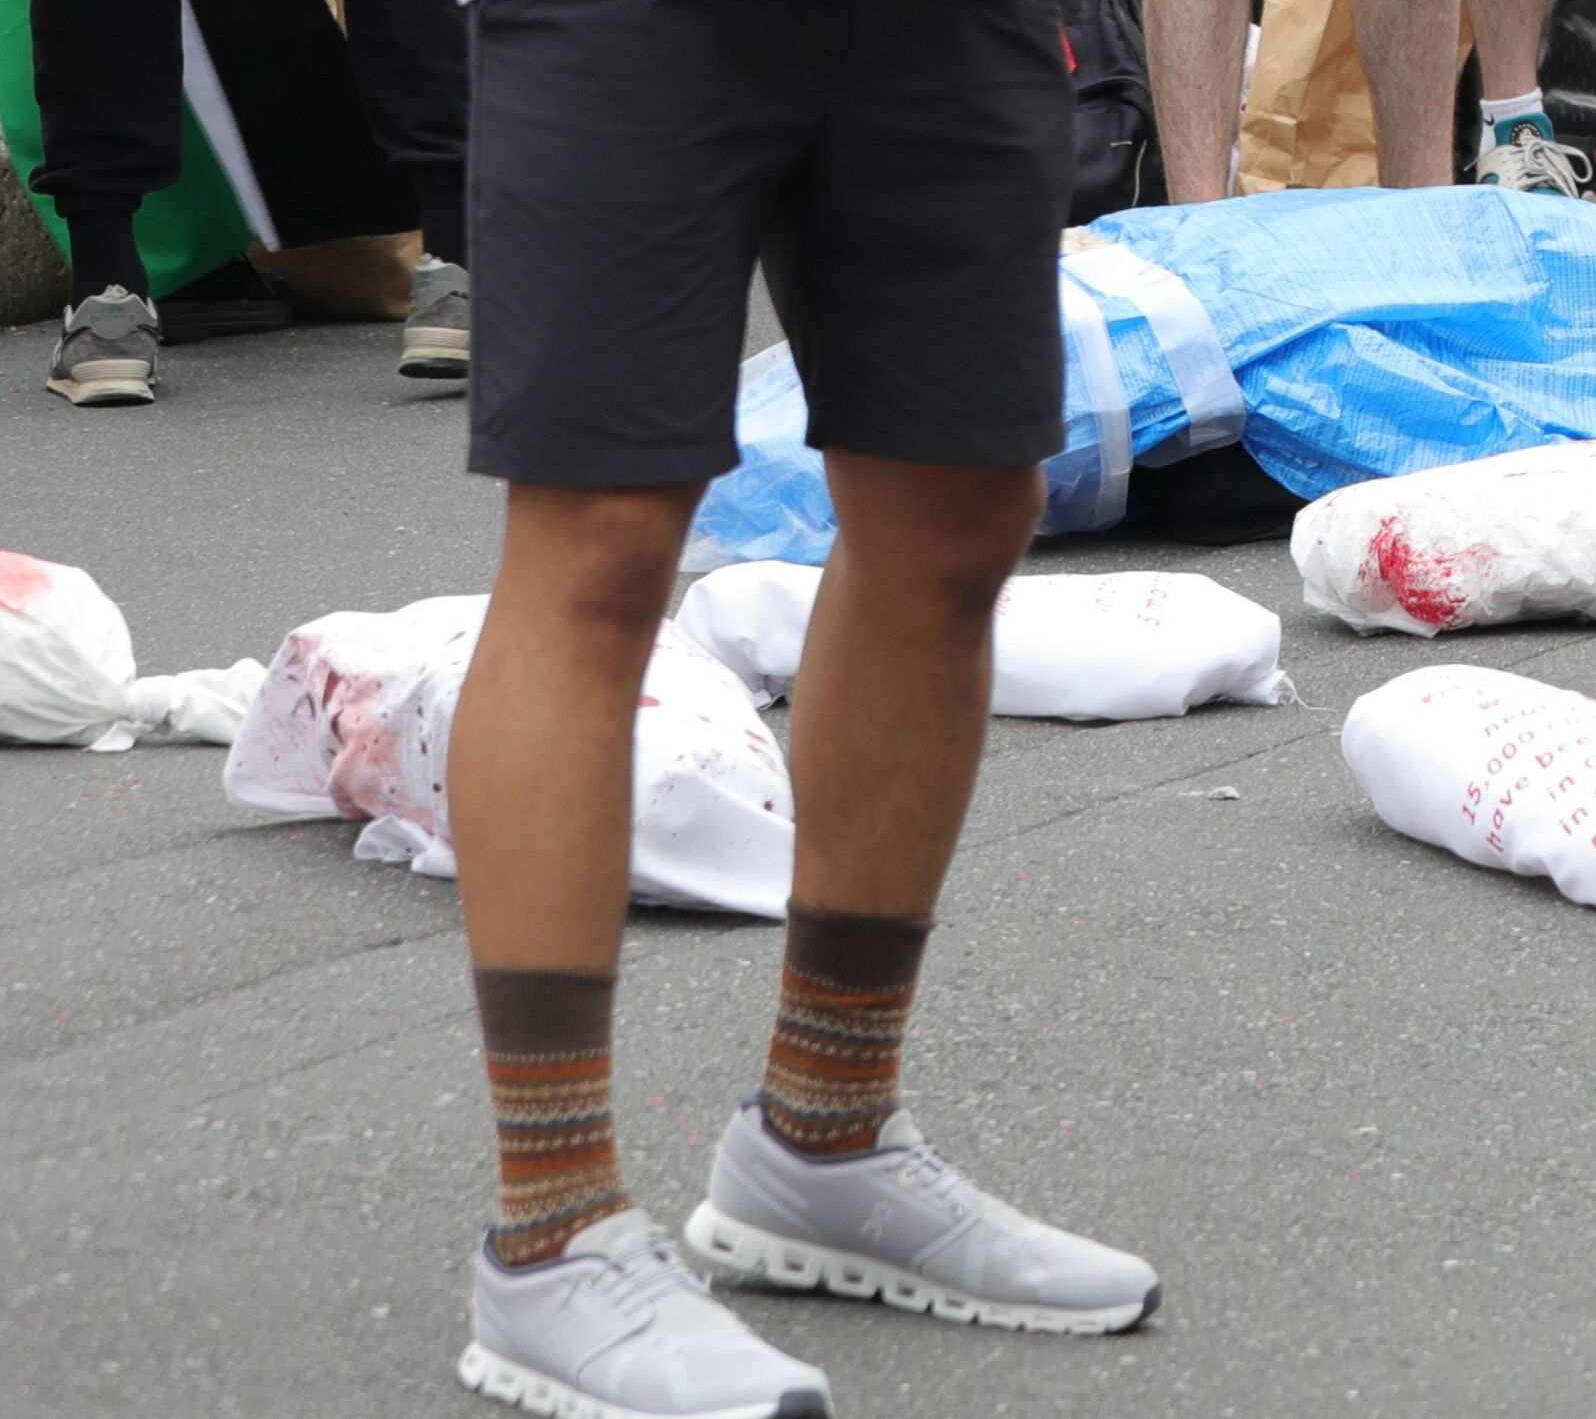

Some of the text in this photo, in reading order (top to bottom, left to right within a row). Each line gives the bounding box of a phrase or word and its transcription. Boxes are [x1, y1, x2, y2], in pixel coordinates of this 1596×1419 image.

[1461, 729, 1535, 826] 15,000
[1546, 774, 1577, 802] in
[1485, 774, 1531, 854] have
[1557, 804, 1591, 838] in
